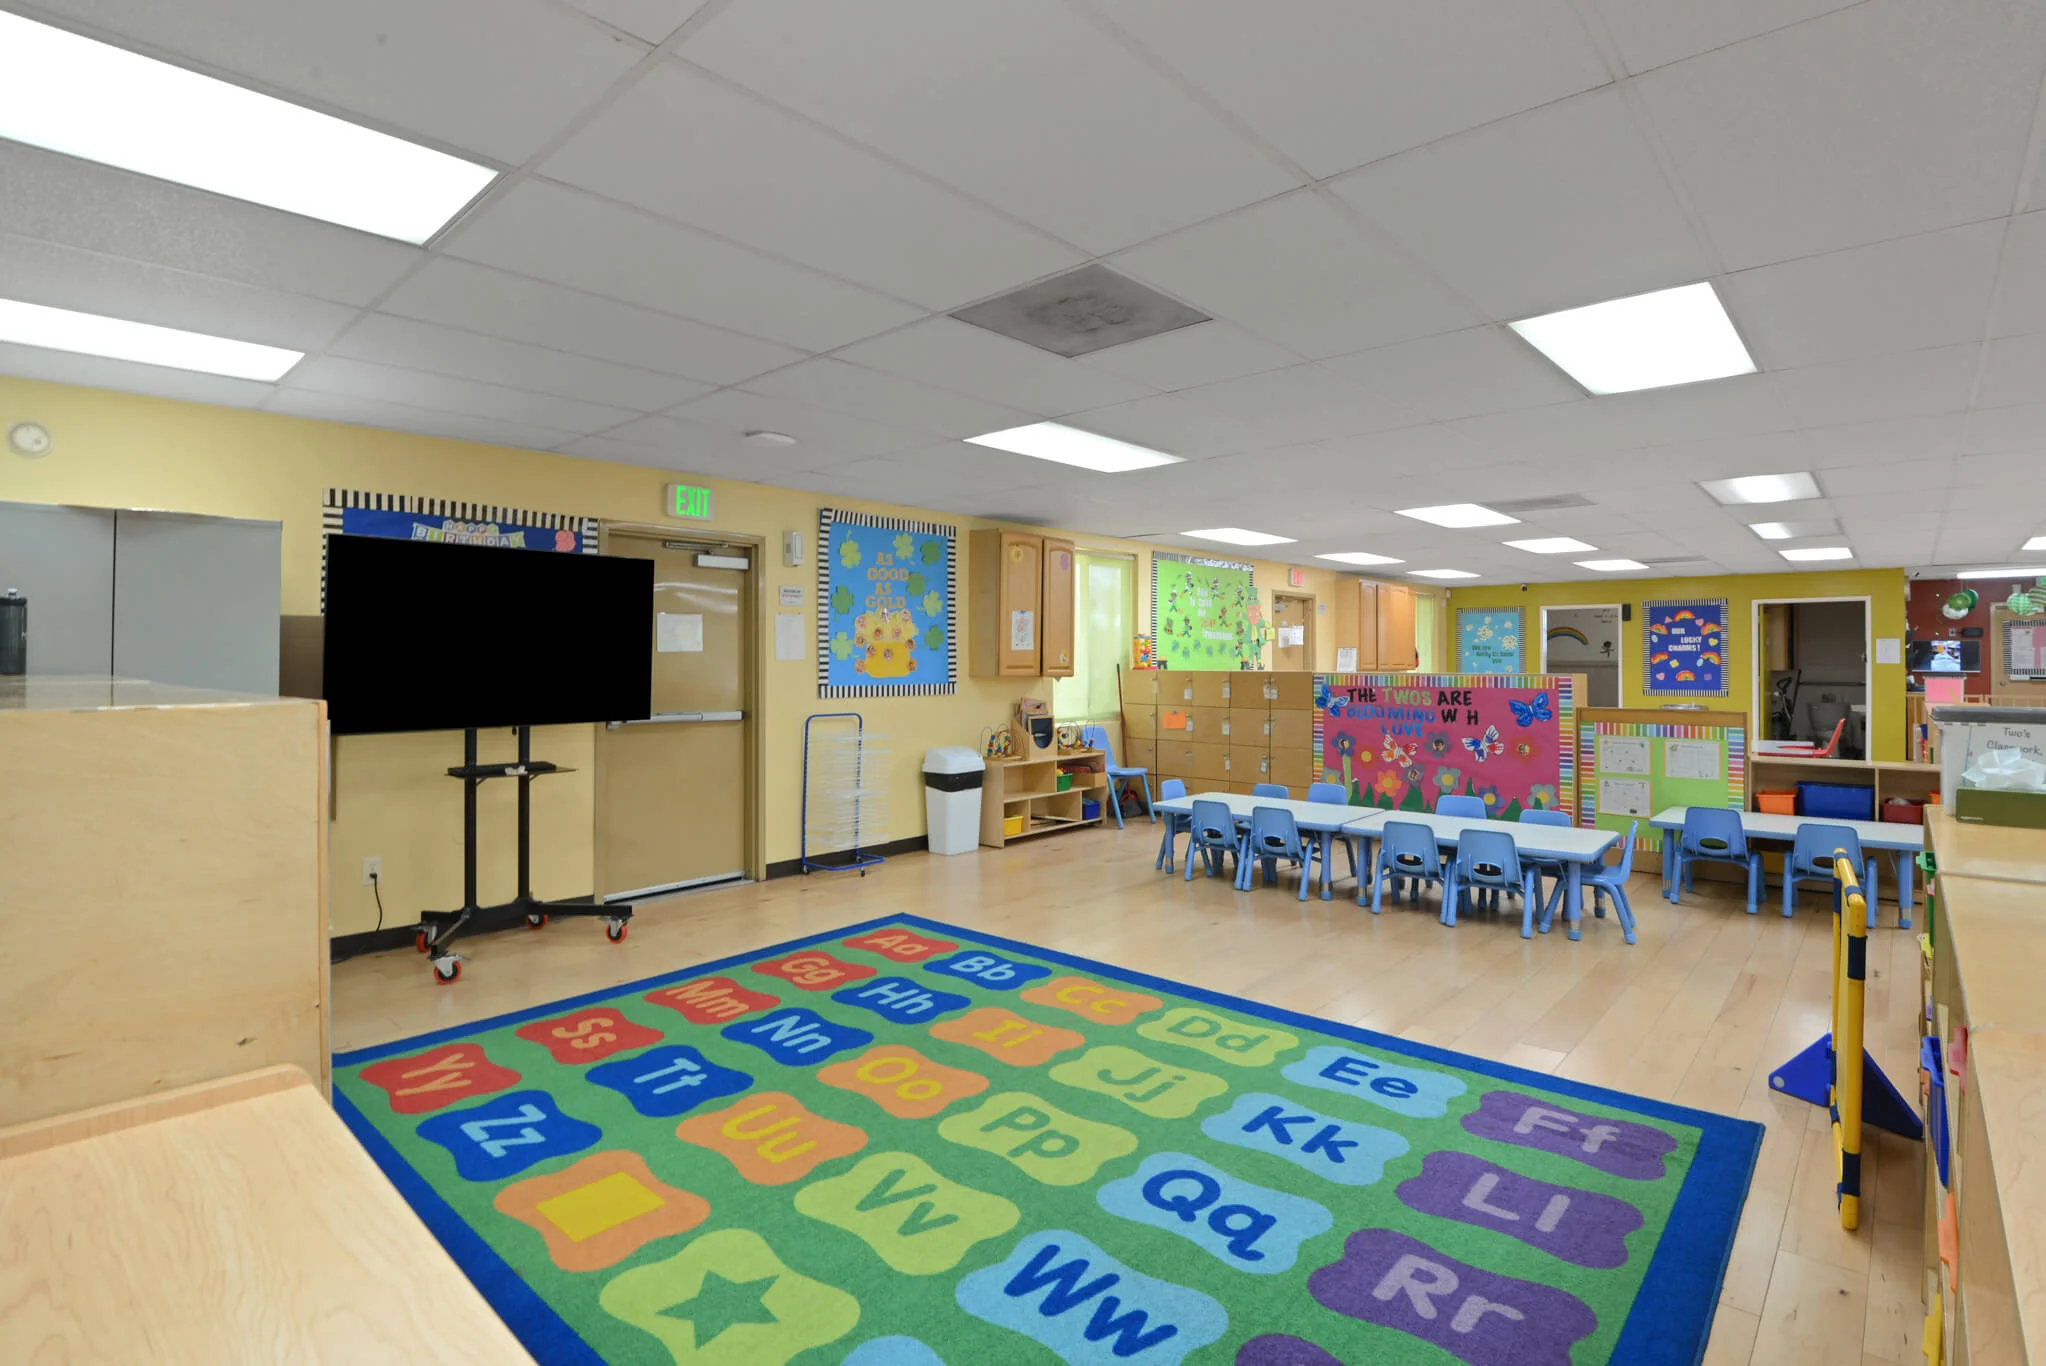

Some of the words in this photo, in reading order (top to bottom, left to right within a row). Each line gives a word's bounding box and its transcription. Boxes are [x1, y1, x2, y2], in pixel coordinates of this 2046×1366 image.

[676, 486, 711, 518] EXIT
[415, 526, 522, 547] BIRTHDAY
[445, 522, 496, 534] HAPPY
[867, 567, 909, 581] GOOD
[876, 552, 893, 566] AS
[865, 595, 907, 609] GOLD
[875, 582, 892, 595] AS
[1347, 688, 1377, 703] THE
[1381, 687, 1433, 705] TWOS
[1437, 690, 1472, 706] ARE
[1380, 722, 1425, 737] LOVE
[864, 934, 929, 956] Aa
[780, 956, 845, 984] Gg
[949, 956, 1016, 982] Bb
[666, 980, 750, 1018] Mm
[858, 983, 934, 1015] Hh
[1055, 985, 1127, 1014] Cc
[551, 1017, 617, 1049] Ss
[751, 1015, 832, 1054] Nn
[972, 1019, 1044, 1048] Ii
[1167, 1015, 1271, 1053] Dd
[395, 1053, 476, 1096] Yy
[633, 1057, 708, 1095] Tt
[856, 1057, 943, 1100] Oo
[1097, 1066, 1187, 1104] Jj
[1318, 1056, 1419, 1099] Ee
[460, 1104, 547, 1158] Zz
[720, 1104, 819, 1164] Uu
[980, 1106, 1080, 1159] Pp
[1241, 1105, 1359, 1164] Kk
[1512, 1105, 1623, 1154] Ff
[854, 1168, 959, 1237] Vv
[1142, 1169, 1277, 1261] Qq
[1002, 1244, 1178, 1358] Ww
[1371, 1254, 1526, 1334] Rr
